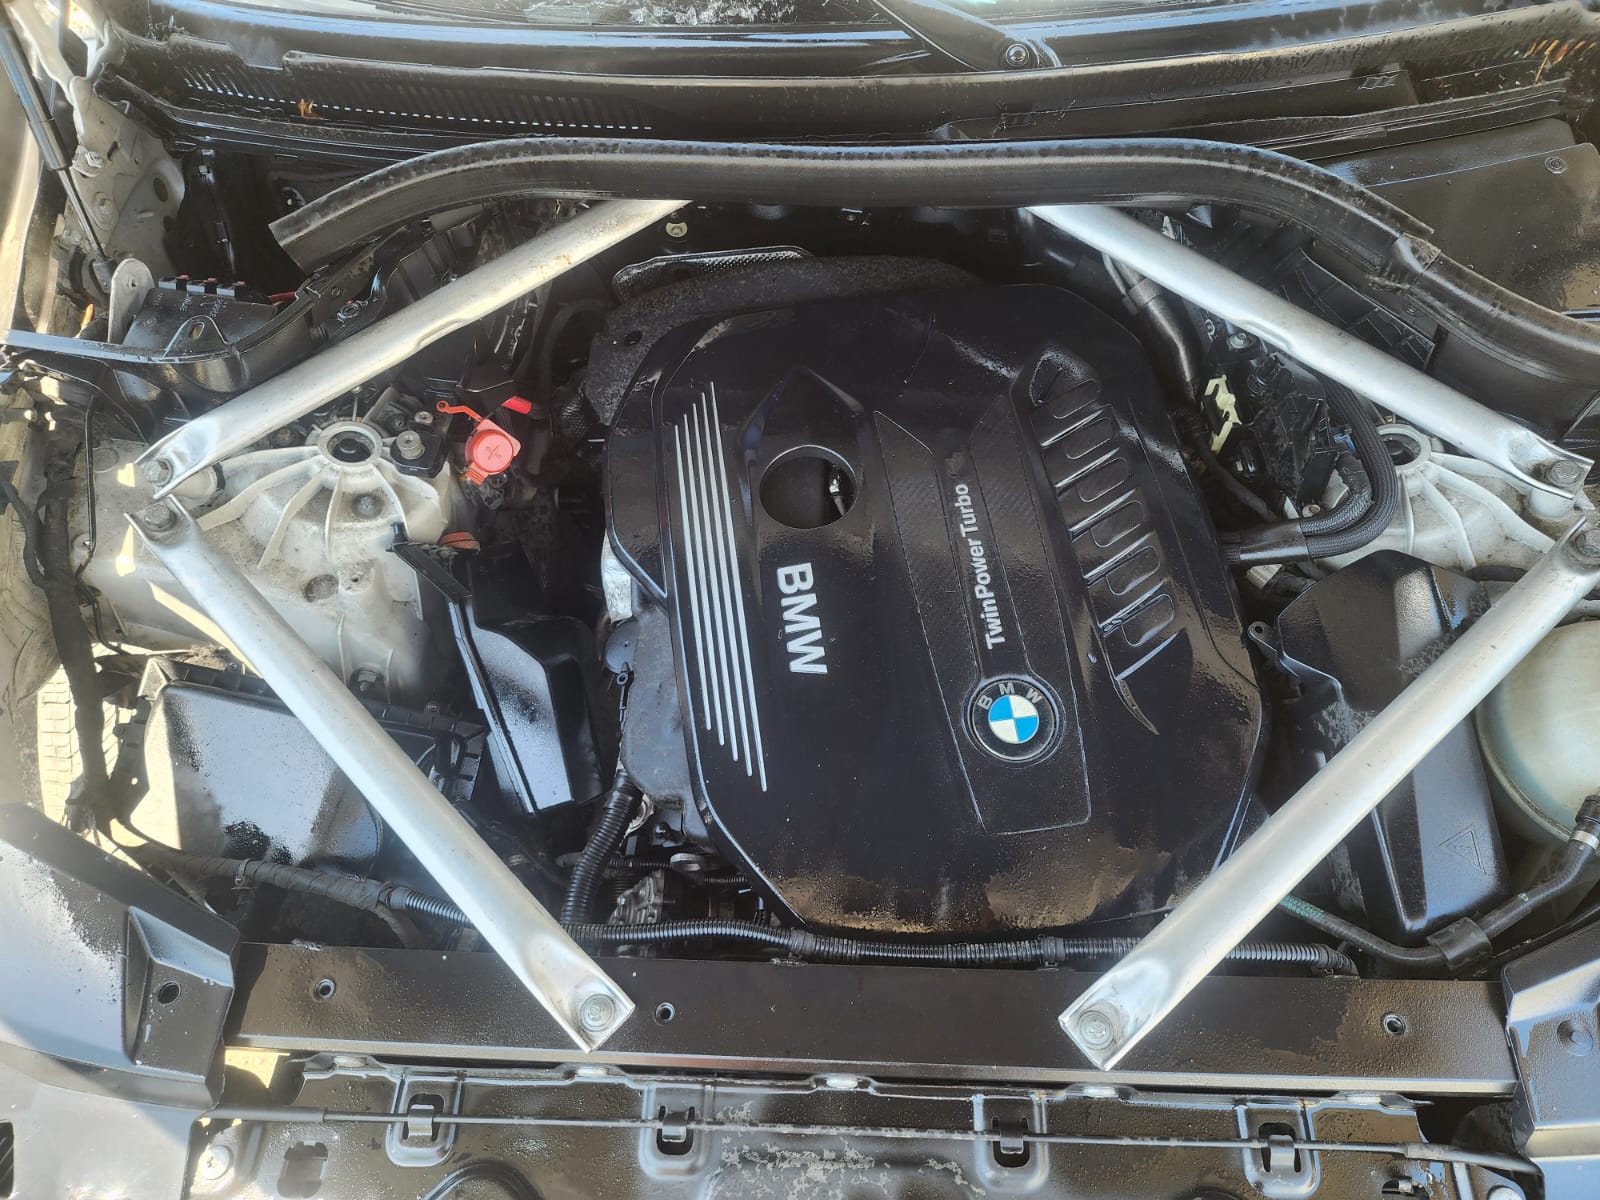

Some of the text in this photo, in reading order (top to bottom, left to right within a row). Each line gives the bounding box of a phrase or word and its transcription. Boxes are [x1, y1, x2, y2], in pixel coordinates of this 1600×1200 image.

[777, 562, 828, 674] BMW
[954, 484, 1006, 650] TwinPower Turbo
[977, 682, 1043, 710] BMW
